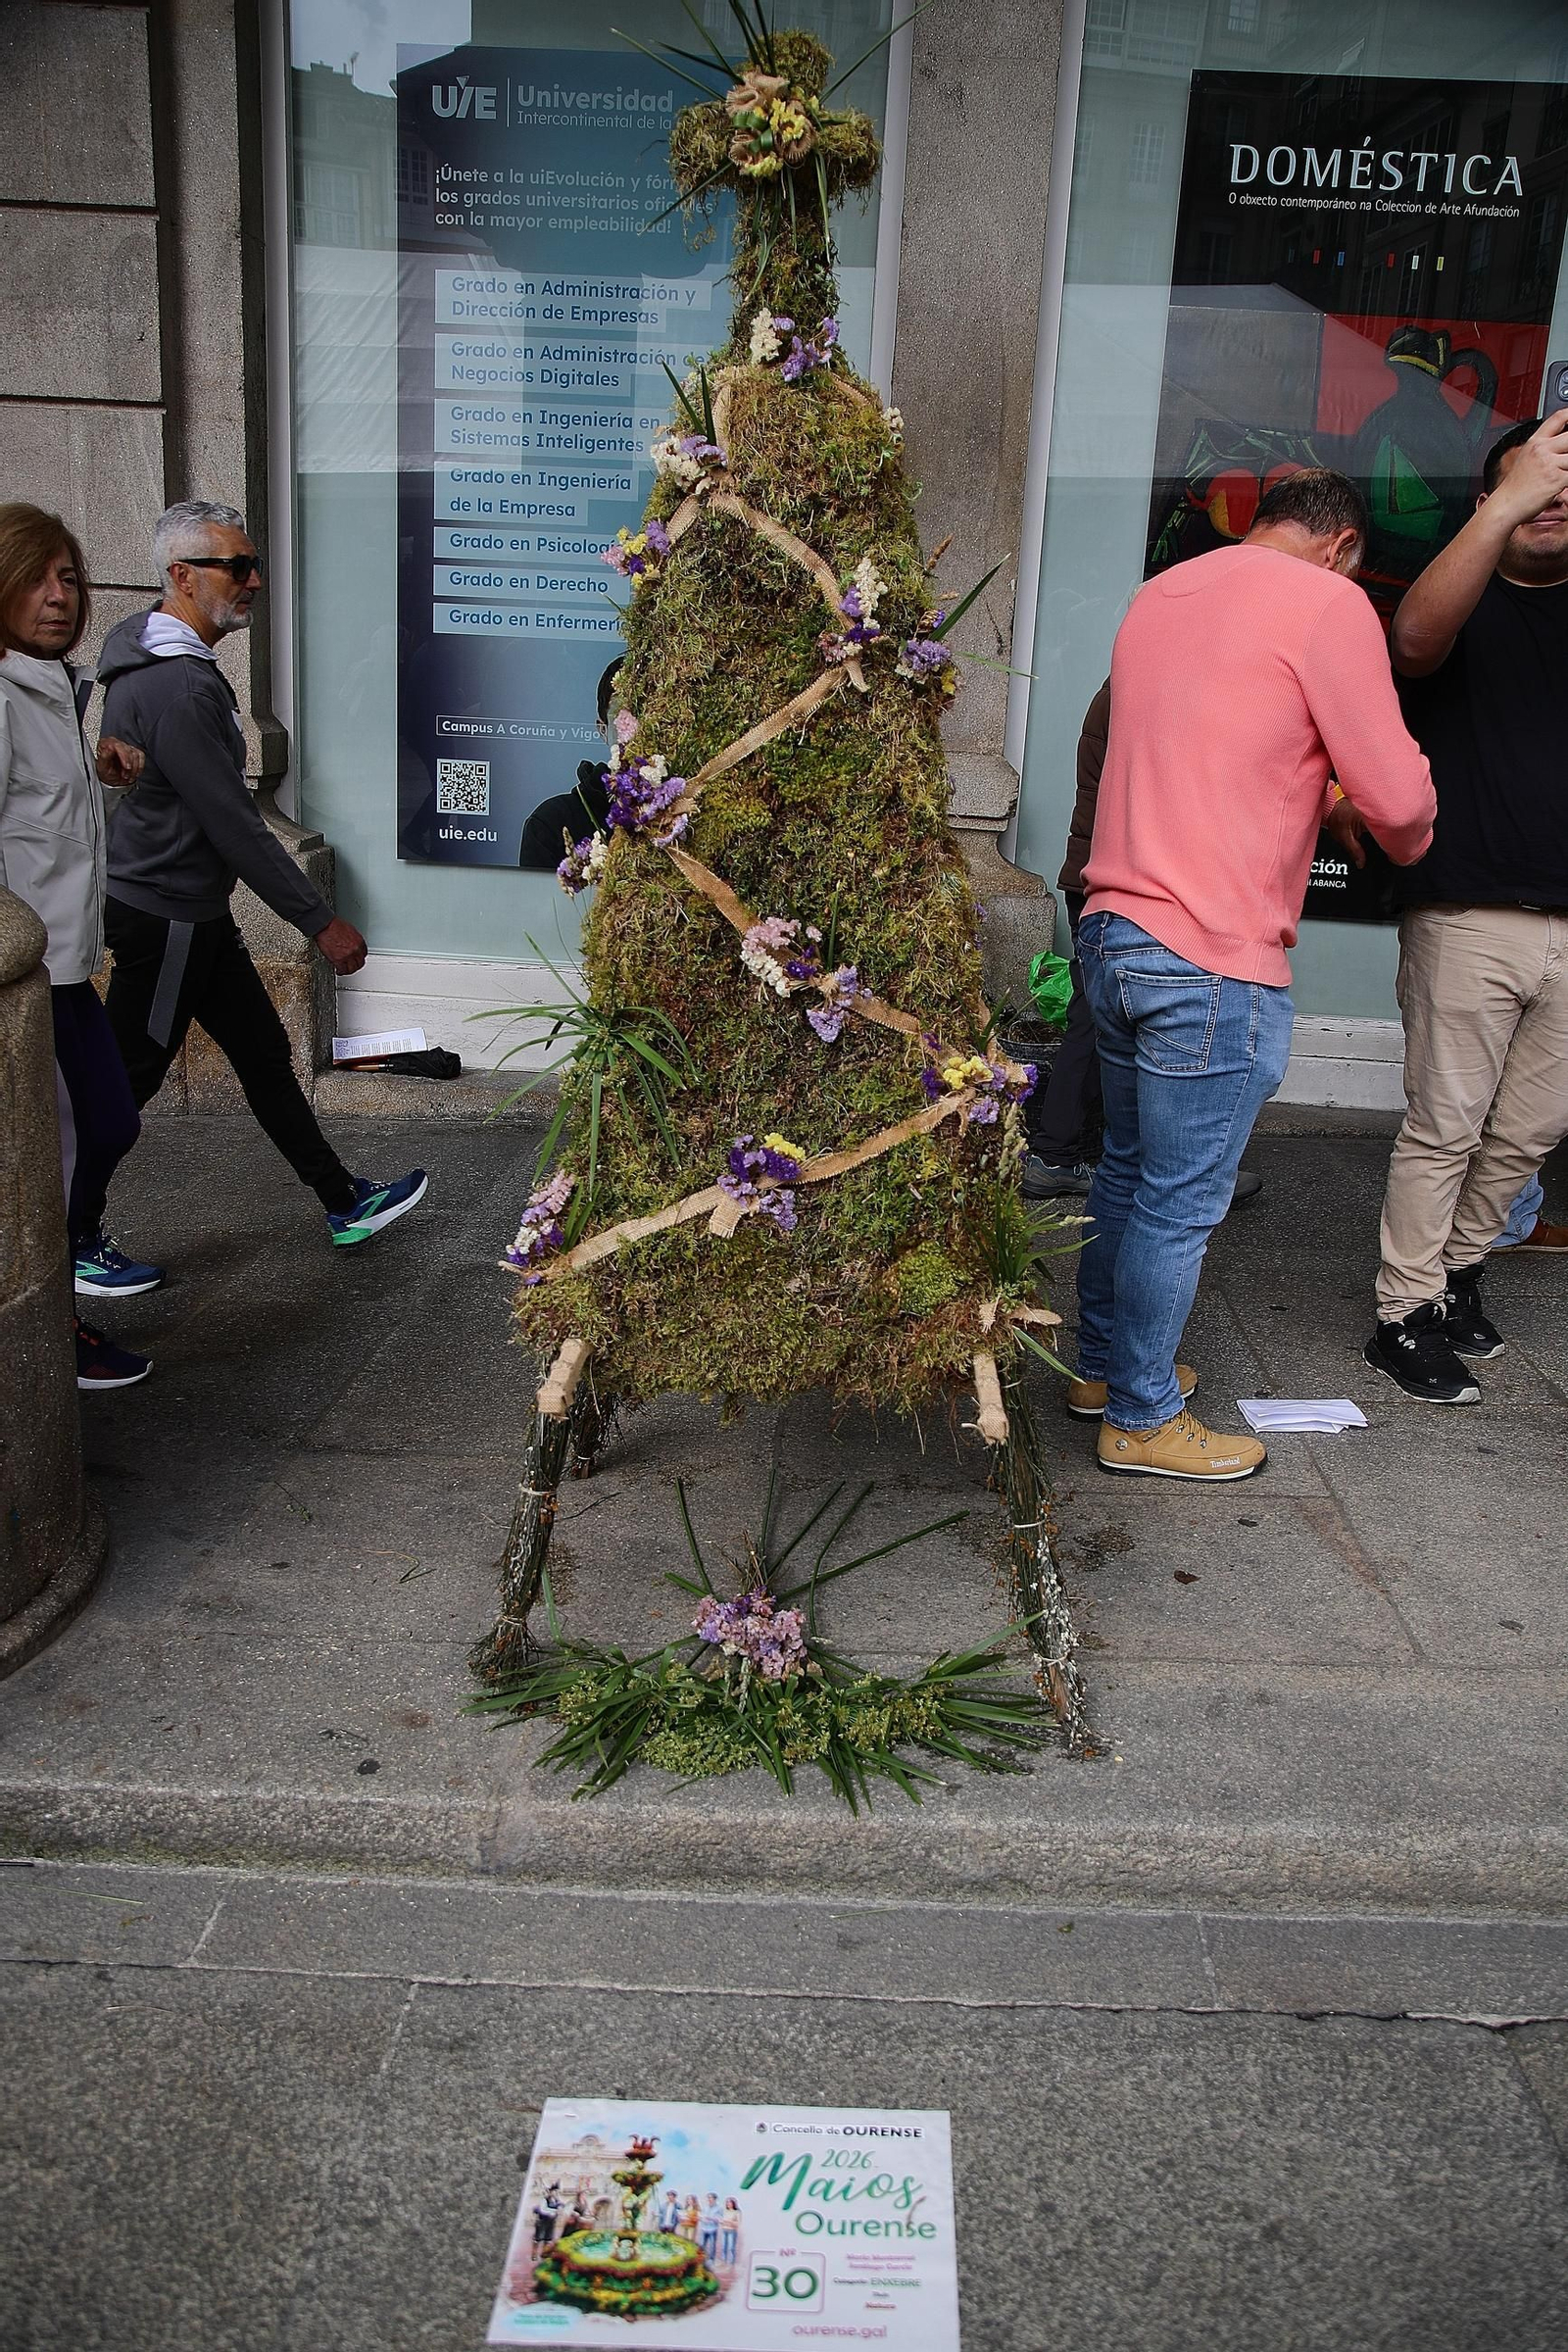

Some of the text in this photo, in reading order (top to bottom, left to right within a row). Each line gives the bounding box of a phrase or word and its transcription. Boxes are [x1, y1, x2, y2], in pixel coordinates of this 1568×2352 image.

[517, 84, 673, 113] Universidad
[517, 111, 672, 130] Intercontinental de la
[435, 163, 488, 184] ¡Únete
[493, 172, 504, 183] a
[510, 169, 524, 184] la
[530, 169, 624, 188] uiEvolución
[631, 175, 640, 192] y
[1229, 136, 1524, 196] DOMÉSTICA
[435, 188, 459, 203] los
[464, 190, 520, 208] grados
[526, 192, 638, 211] universitarios
[1229, 192, 1237, 205] O
[1240, 193, 1278, 206] obxecto
[1280, 195, 1356, 213] contemporáneo
[1359, 201, 1372, 211] na
[1425, 201, 1438, 214] de
[1440, 202, 1460, 215] Arte
[1463, 202, 1520, 218] Afundación
[435, 211, 671, 235] con la mayor empleabilidad!
[452, 276, 696, 306] Grado en Administración y
[452, 300, 659, 326] Dirección de Empresas
[451, 342, 507, 359] Grado
[513, 347, 534, 360] en
[540, 345, 676, 367] Administración
[452, 366, 619, 388] Negocios Digitales
[451, 407, 661, 430] Grado en Ingeniería en
[451, 429, 644, 454] Sistemas Inteligentes
[450, 468, 631, 491] Grado en Ingeniería
[450, 497, 576, 519] de la Empresa
[450, 533, 505, 550] Grado
[510, 539, 531, 552] en
[449, 571, 609, 593] Grado en Derecho
[449, 610, 503, 626] Grado
[509, 614, 529, 627] en
[442, 720, 601, 741] Campus A Coruña y Vigo
[439, 825, 498, 843] uie.edu
[1312, 879, 1347, 889] ABANCA
[1210, 1455, 1240, 1468] Timberland
[773, 2125, 922, 2138] Concello de OURENSE
[821, 2148, 876, 2169] 2026
[740, 2152, 924, 2210] Maios
[795, 2210, 937, 2239] Ourense
[752, 2265, 819, 2300] 30
[792, 2325, 888, 2339] ourense.gal
